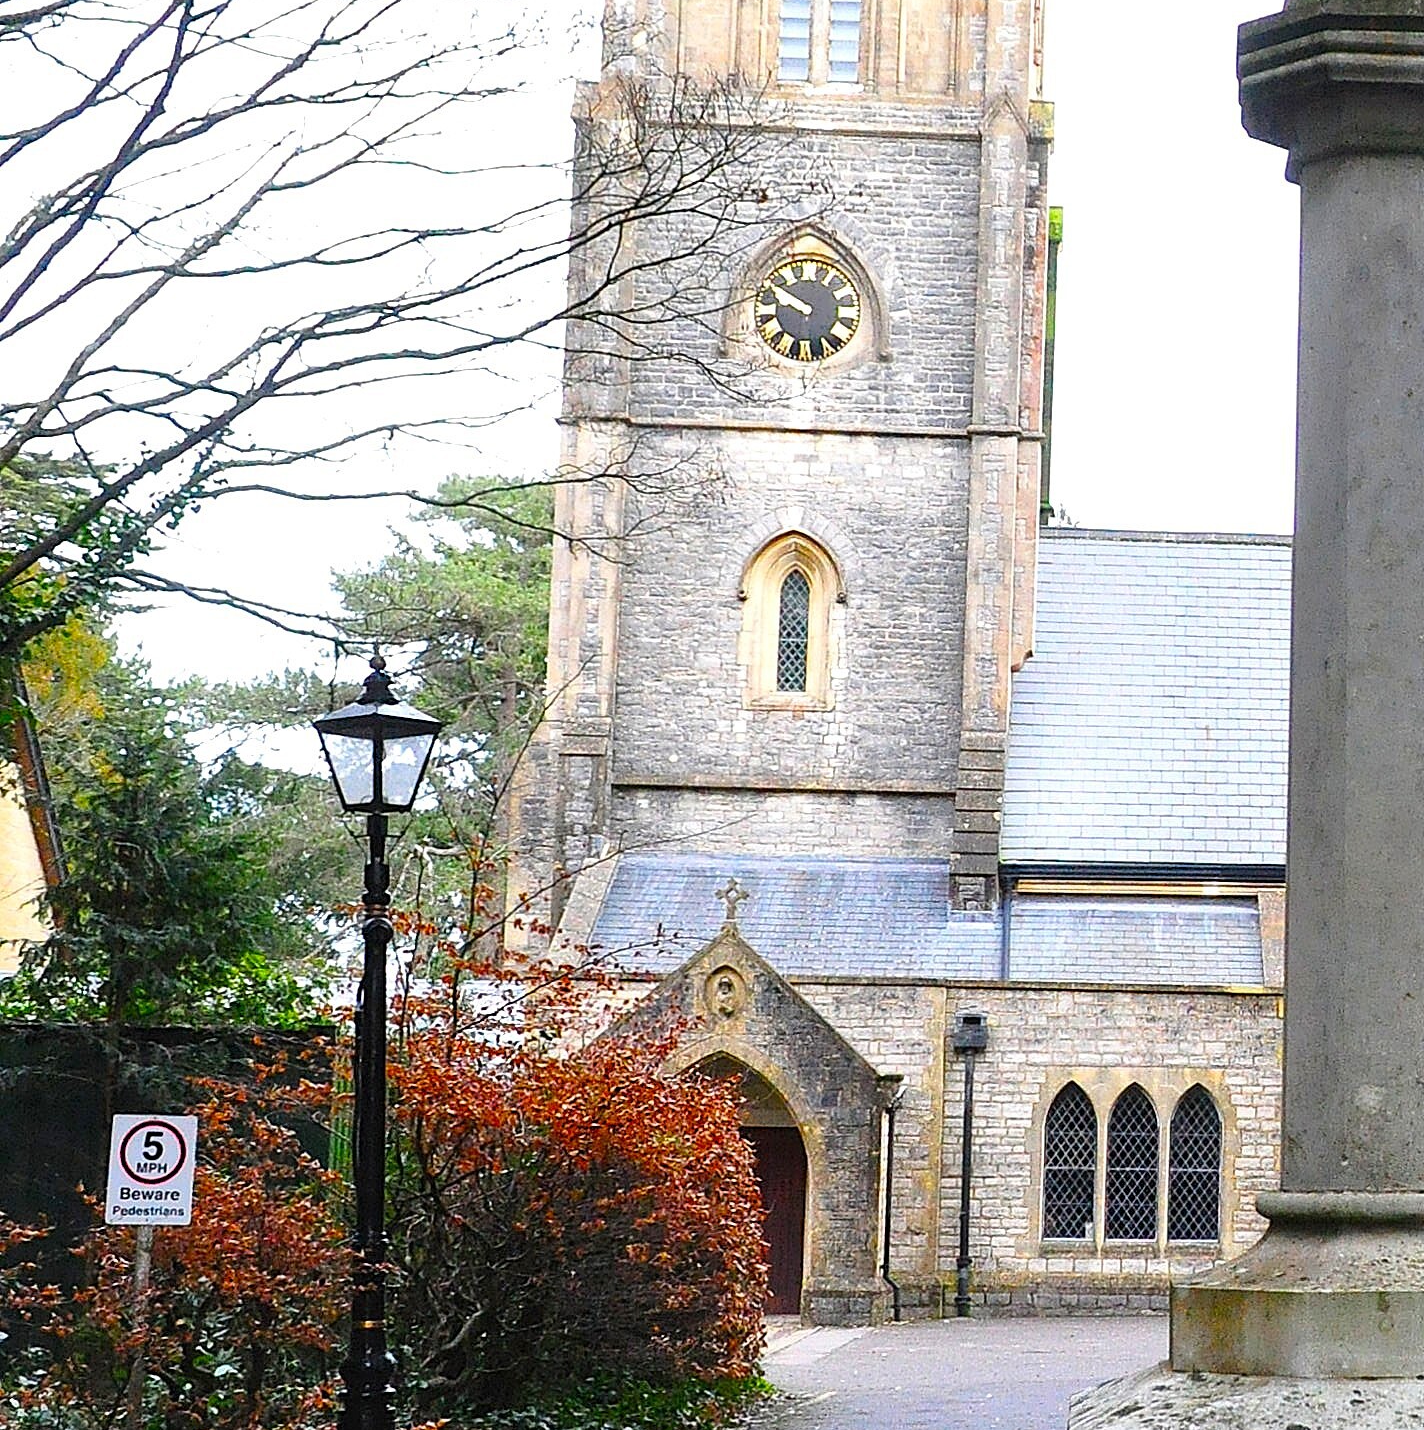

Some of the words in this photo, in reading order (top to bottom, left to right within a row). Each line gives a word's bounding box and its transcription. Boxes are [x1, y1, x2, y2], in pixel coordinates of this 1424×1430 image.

[142, 1131, 164, 1161] 5
[136, 1162, 168, 1174] MPH
[119, 1186, 181, 1201] Beware
[112, 1205, 185, 1217] Pedestrians
